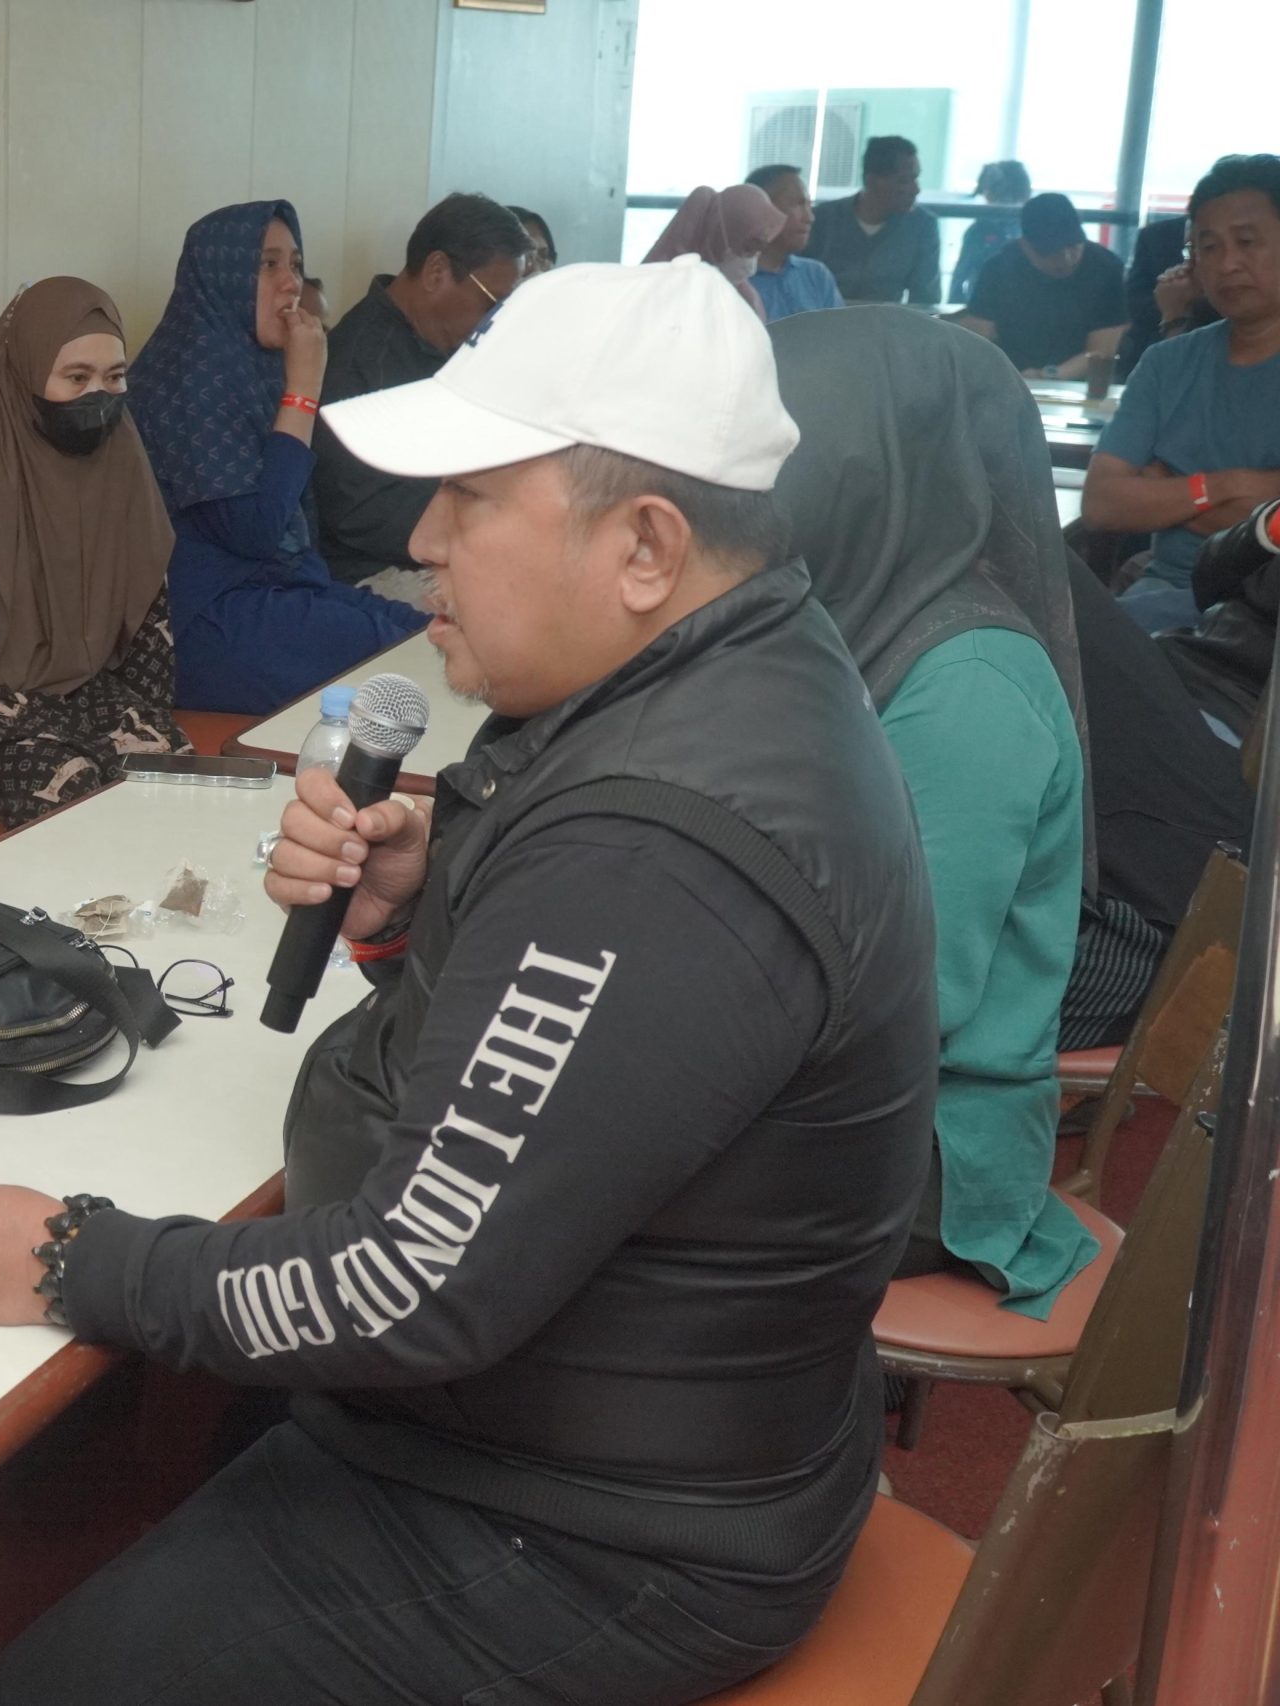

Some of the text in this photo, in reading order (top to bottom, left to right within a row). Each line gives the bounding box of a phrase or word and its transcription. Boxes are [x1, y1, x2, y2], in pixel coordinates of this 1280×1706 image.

[216, 942, 616, 1359] THE LION OF GOD
